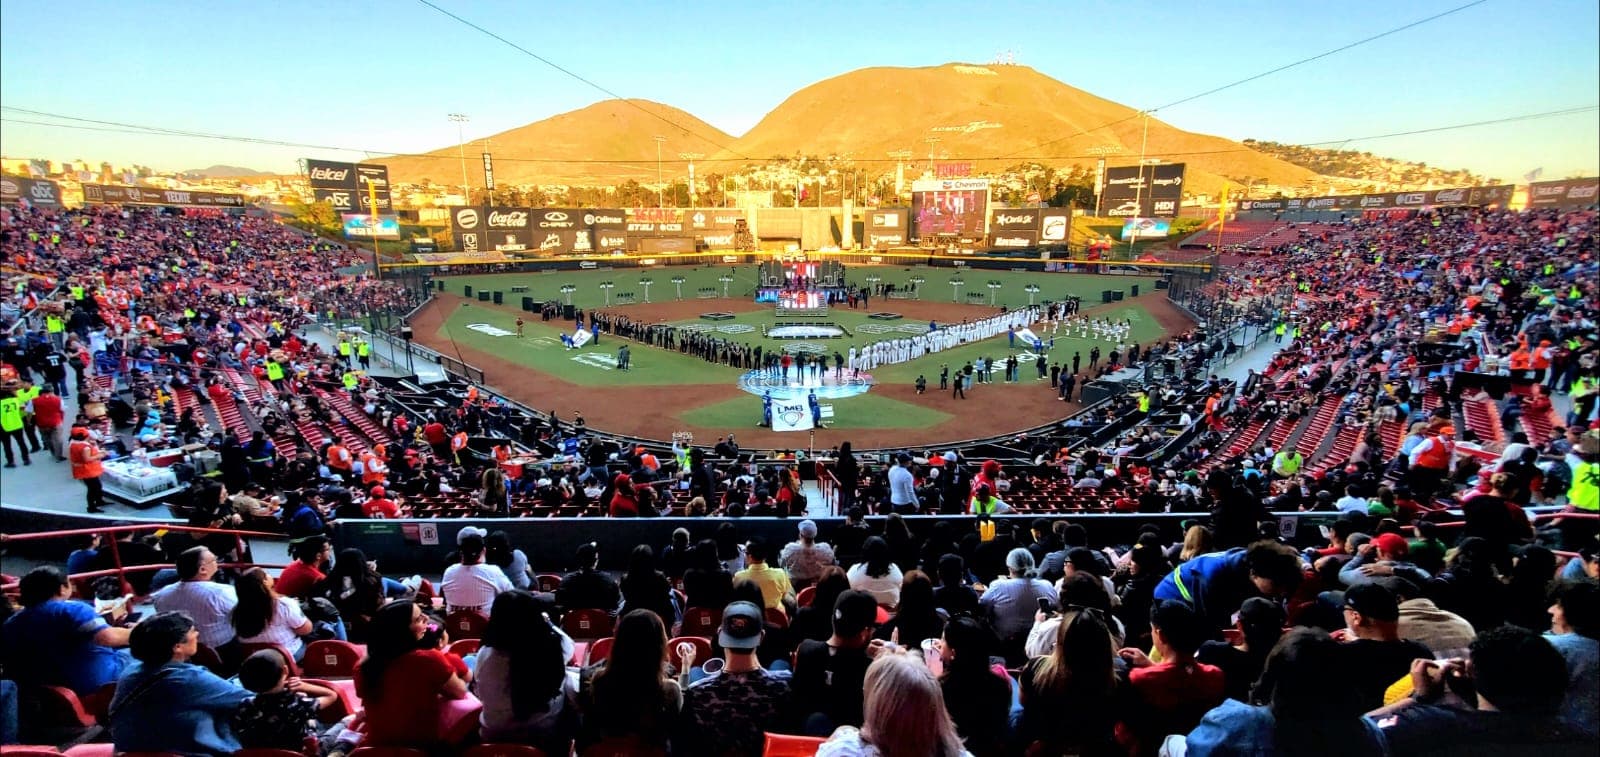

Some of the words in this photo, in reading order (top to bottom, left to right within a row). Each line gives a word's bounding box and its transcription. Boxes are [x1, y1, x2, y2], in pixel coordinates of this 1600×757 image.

[311, 167, 348, 180] telcel
[1155, 201, 1175, 210] HDI
[488, 211, 528, 227] Coca-Cola
[777, 404, 804, 415] LMB
